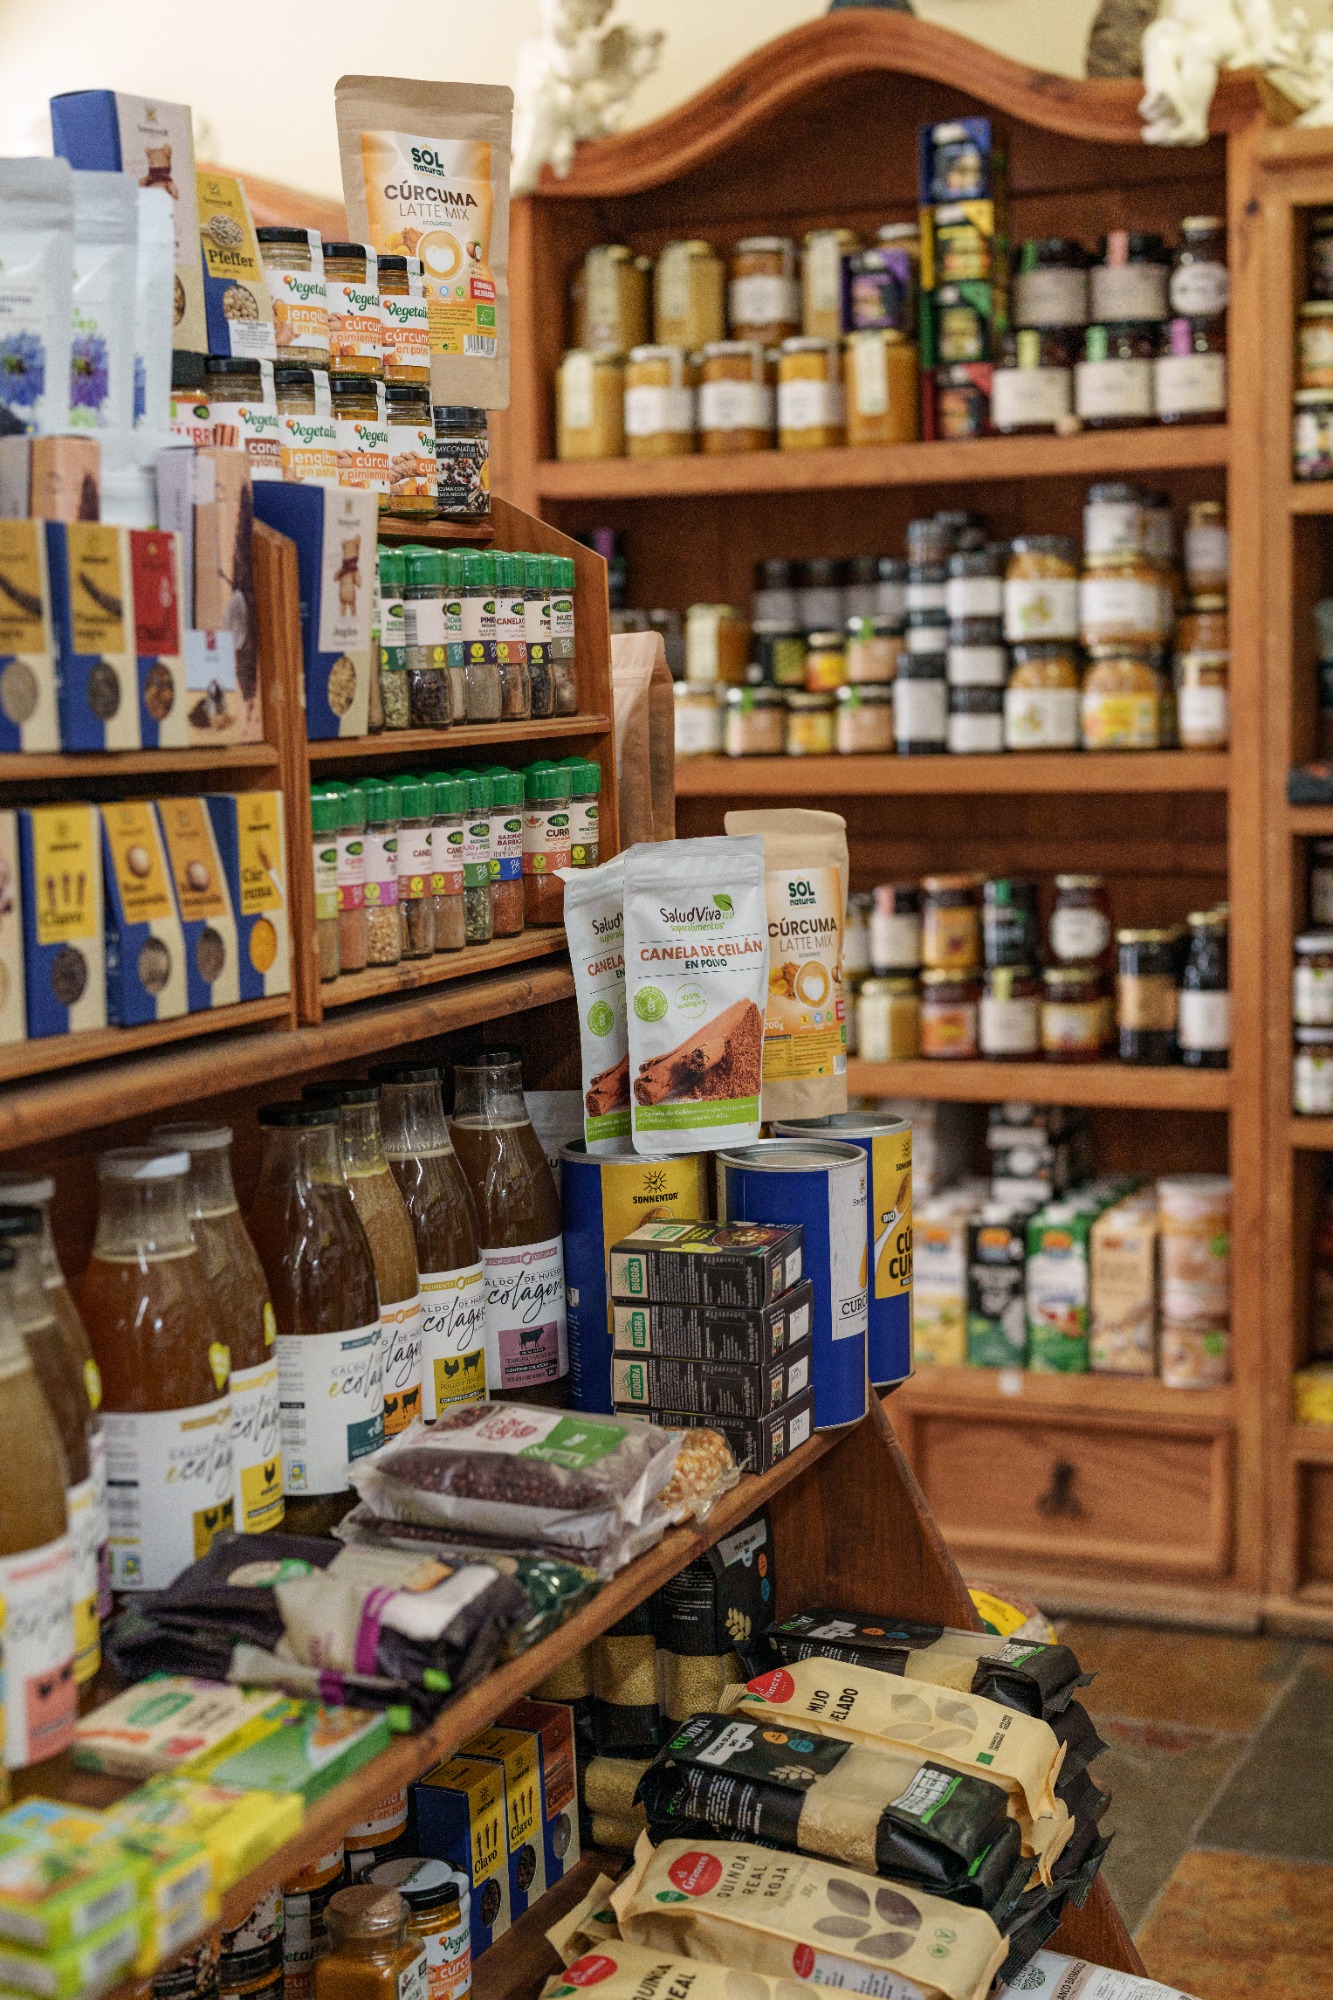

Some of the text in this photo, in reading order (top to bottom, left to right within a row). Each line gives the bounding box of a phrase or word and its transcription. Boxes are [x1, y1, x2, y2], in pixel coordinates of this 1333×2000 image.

[411, 147, 444, 170] SOL
[413, 163, 445, 178] natural
[384, 179, 478, 208] CÚRCUMA
[400, 202, 470, 221] LATTE MIX
[208, 248, 254, 268] Pfeffer
[788, 880, 816, 898] SOL
[789, 897, 817, 907] natural
[768, 917, 838, 938] CÚRCUMA
[640, 938, 763, 962] CANELA DE CEILÁN
[779, 934, 834, 953] LATTE MIX
[587, 954, 625, 977] CANELA
[615, 968, 625, 979] EN
[685, 958, 728, 969] EN POLVO
[633, 1192, 678, 1204] SONNENTOR
[882, 1211, 895, 1223] BIO
[524, 1275, 536, 1283] DE
[458, 1300, 470, 1308] DE
[805, 1690, 830, 1714] MIJO
[510, 1816, 533, 1841] Clavo
[474, 1849, 498, 1875] Clavo
[717, 1854, 750, 1899] QUINOA
[742, 1865, 768, 1896] REAL
[764, 1866, 790, 1898] ROJA
